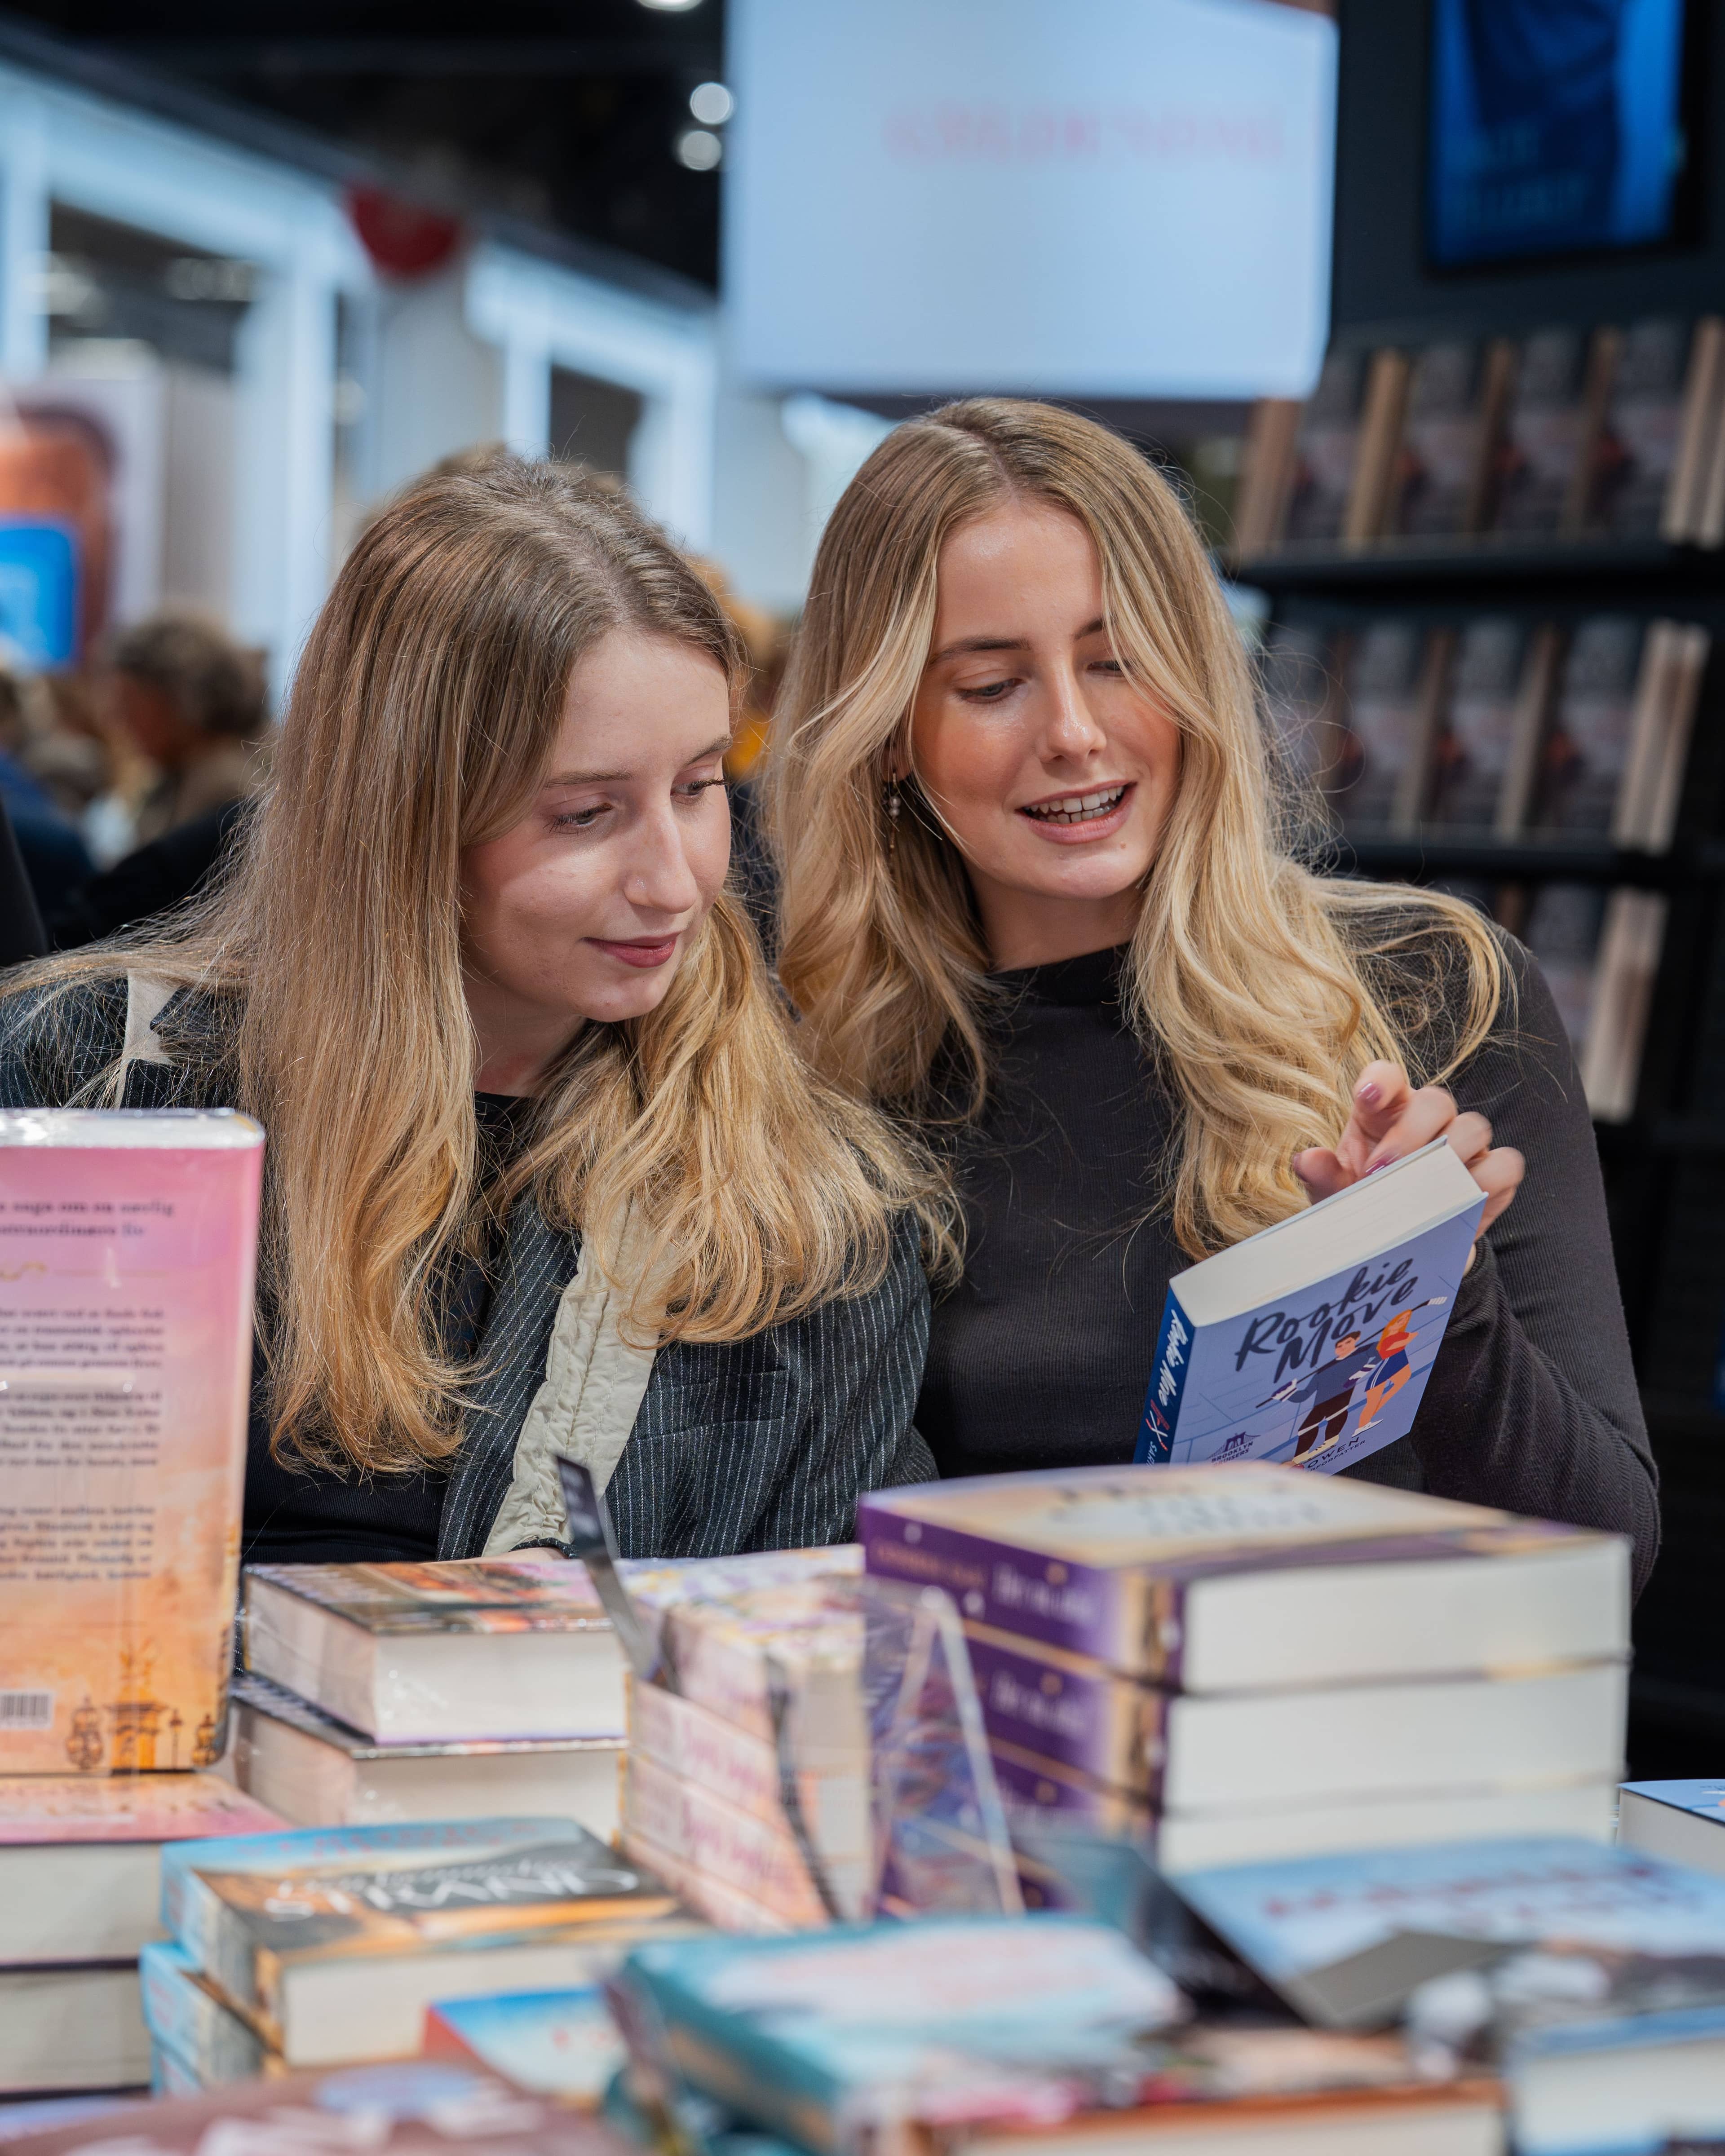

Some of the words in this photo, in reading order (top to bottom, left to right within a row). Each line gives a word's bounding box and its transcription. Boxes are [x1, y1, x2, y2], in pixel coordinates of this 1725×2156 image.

[1235, 1259, 1413, 1371] Rookie
[1273, 1277, 1418, 1383] Move
[1212, 1441, 1253, 1462] BROOKLYN
[1214, 1448, 1249, 1465] RUISERS
[1308, 1437, 1359, 1468] OWEN
[1308, 1440, 1366, 1473] RFORFATTER
